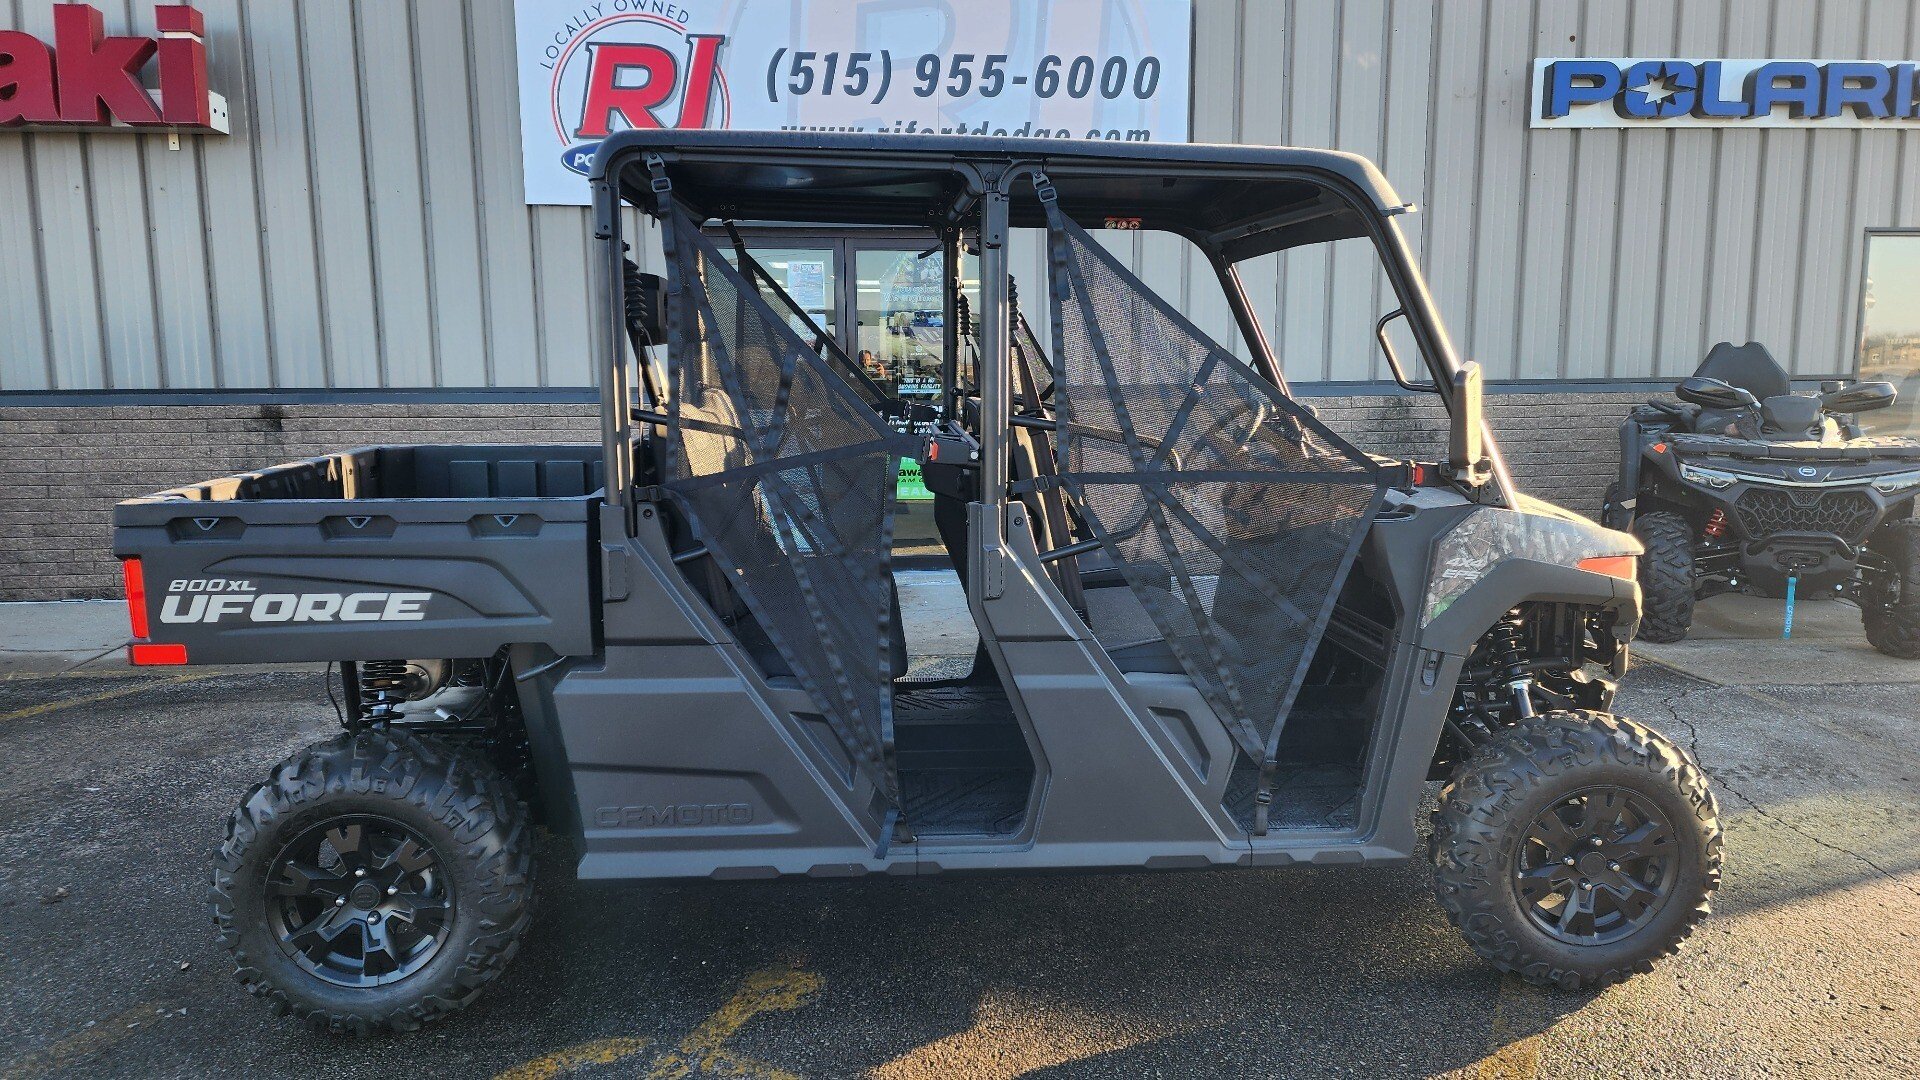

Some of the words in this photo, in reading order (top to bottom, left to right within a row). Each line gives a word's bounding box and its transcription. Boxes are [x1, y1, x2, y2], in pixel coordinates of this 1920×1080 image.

[540, 2, 603, 70] LOCALLY
[613, 0, 689, 24] OWNED
[573, 33, 729, 139] RI
[766, 47, 892, 105] (515)
[912, 53, 1161, 100] 955-6000
[1542, 60, 1920, 119] POLARI
[1442, 568, 1481, 580] EPS
[159, 592, 432, 624] UFORCE
[595, 803, 753, 828] CFMOTO
